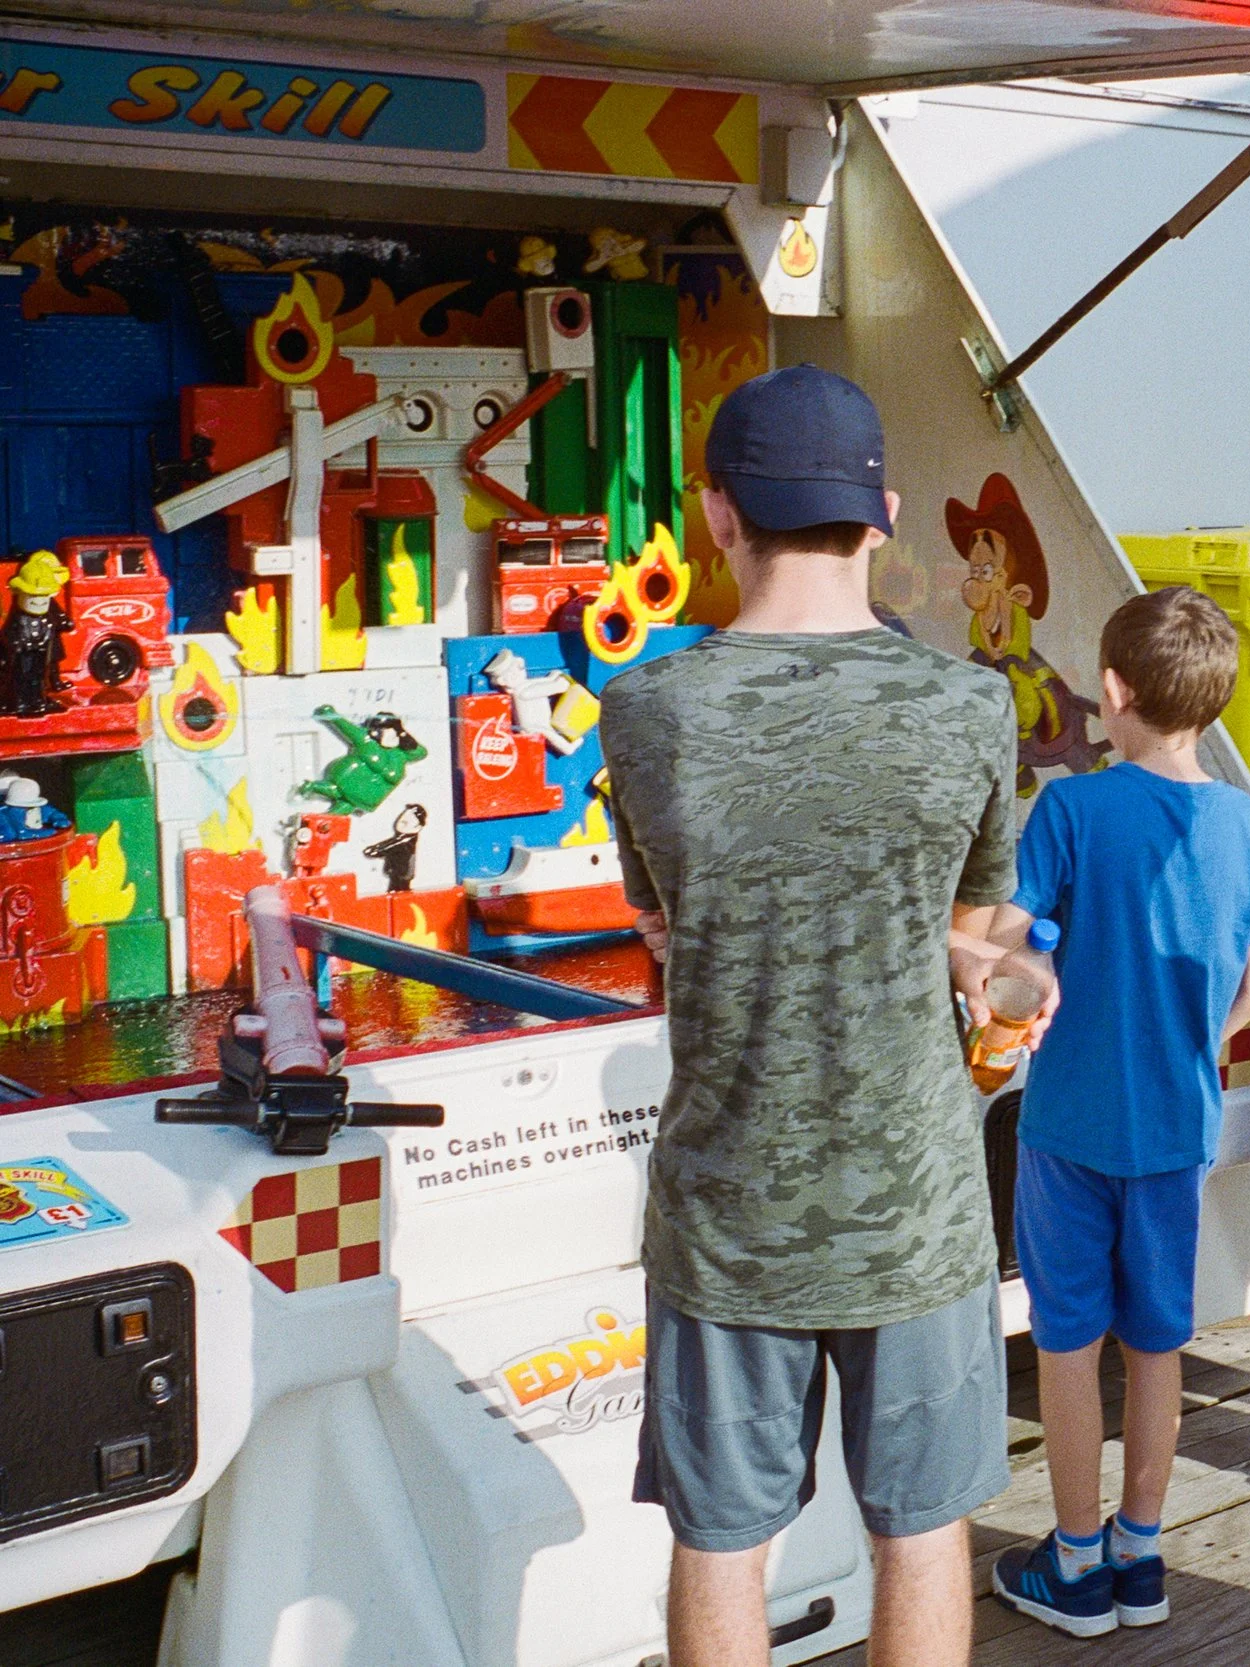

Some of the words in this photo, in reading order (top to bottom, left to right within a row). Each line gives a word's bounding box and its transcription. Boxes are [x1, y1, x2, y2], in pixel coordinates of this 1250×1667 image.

[108, 65, 392, 139] Skill
[403, 1146, 435, 1165] No
[448, 1131, 506, 1156] Cash
[517, 1121, 558, 1143] left
[568, 1117, 588, 1134] in
[599, 1104, 660, 1127] these
[12, 1170, 55, 1182] SKILL
[418, 1153, 532, 1189] machines
[47, 1205, 84, 1221] £1
